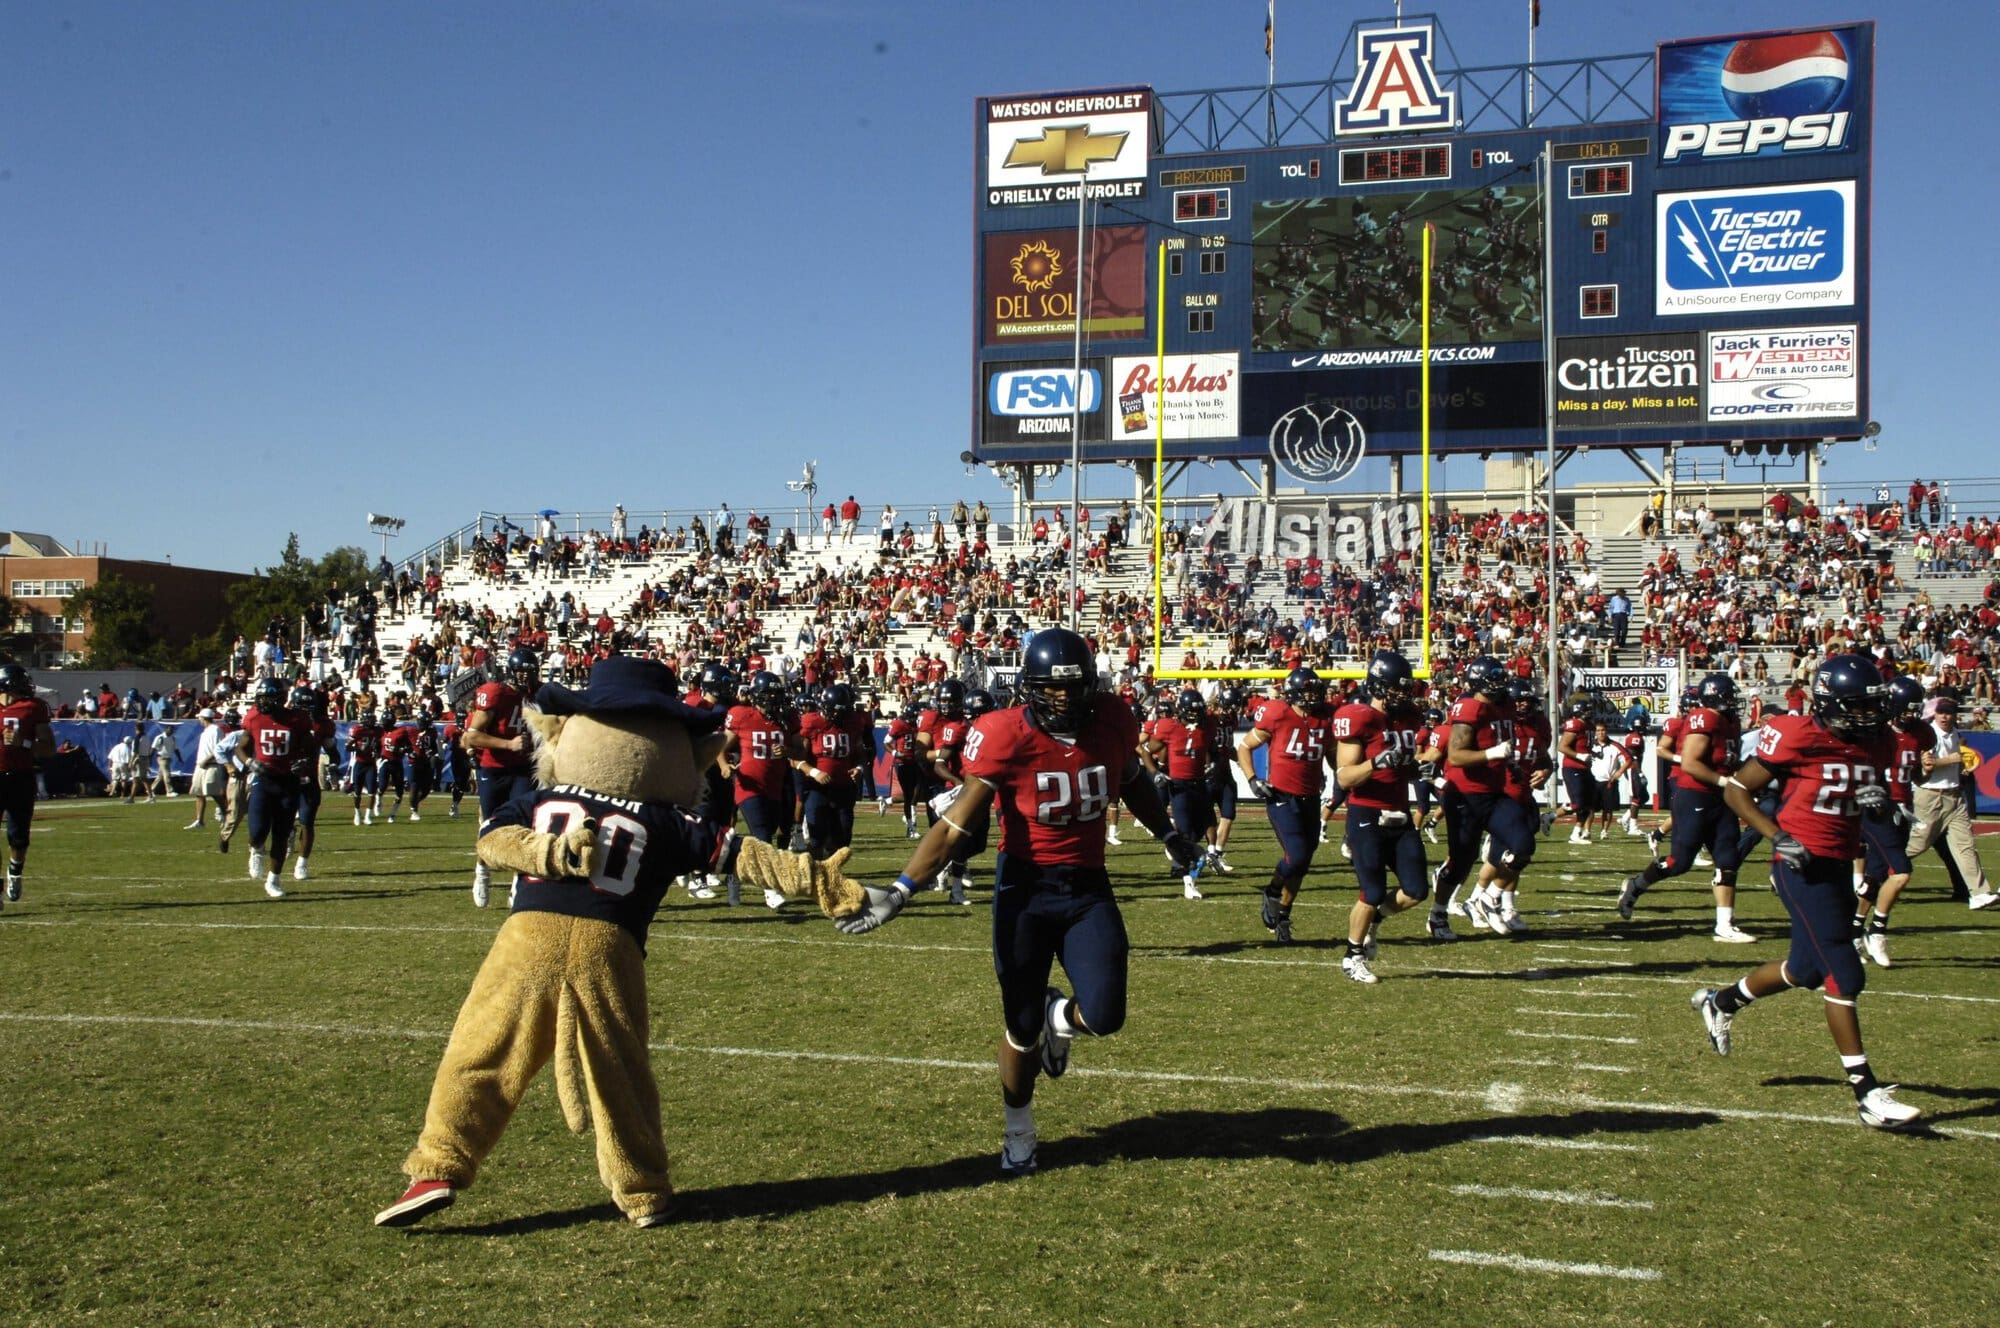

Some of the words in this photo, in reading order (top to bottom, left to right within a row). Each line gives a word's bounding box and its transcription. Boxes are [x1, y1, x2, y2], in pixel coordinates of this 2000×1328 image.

[1335, 25, 1454, 135] A
[991, 102, 1051, 118] WATSON
[1055, 94, 1143, 114] CHEVROLET
[1663, 111, 1850, 160] PEPSI
[1486, 151, 1514, 164] TOL
[1579, 142, 1620, 159] UCLA
[1174, 168, 1233, 185] ARIZONA
[1280, 164, 1306, 178] TOL
[989, 187, 1053, 205] O'RIELLY
[1592, 213, 1609, 226] QTR
[1709, 208, 1802, 231] Tucson
[1167, 238, 1185, 250] DWN
[1213, 235, 1225, 247] GO
[1718, 226, 1827, 252] Electric
[1728, 252, 1826, 274] Power
[997, 295, 1032, 319] DEL
[1040, 293, 1077, 317] SOL
[1185, 296, 1203, 306] BALL
[1206, 295, 1217, 306] ON
[1665, 297, 1674, 307] A
[1677, 294, 1737, 306] UniSource
[1740, 292, 1782, 304] Energy
[1785, 289, 1843, 301] Company
[999, 323, 1075, 335] AVAconcerts.com
[1715, 338, 1760, 351] Jack
[1768, 334, 1851, 348] Furrier's
[1317, 346, 1496, 367] ARIZONAATHLETICS.COM
[1624, 347, 1696, 363] Tucson
[1714, 348, 1851, 380] WESTERN
[1119, 363, 1233, 394] Bashas'
[1558, 356, 1699, 391] Citizen
[1755, 367, 1777, 375] TIRE
[1791, 365, 1818, 374] AUTO
[1821, 364, 1848, 373] CARE
[1006, 375, 1085, 410] FSN
[1195, 400, 1211, 408] You
[1213, 399, 1224, 409] By
[1558, 400, 1588, 411] Miss
[1591, 402, 1599, 410] a
[1603, 399, 1628, 412] day.
[1632, 397, 1662, 408] Miss
[1666, 399, 1674, 407] a
[1677, 396, 1698, 407] lot.
[1018, 418, 1071, 434] ARIZONA
[1148, 413, 1177, 421] Saing
[1179, 413, 1195, 421] You
[1877, 489, 1889, 501] 29
[1201, 500, 1423, 562] Allstate
[1660, 657, 1676, 667] 29
[1585, 675, 1666, 690] BRUEGGER'S
[1334, 718, 1350, 737] 39
[259, 729, 291, 756] 53
[822, 733, 850, 758] 99
[1285, 728, 1324, 762] 45
[1036, 765, 1109, 826] 28
